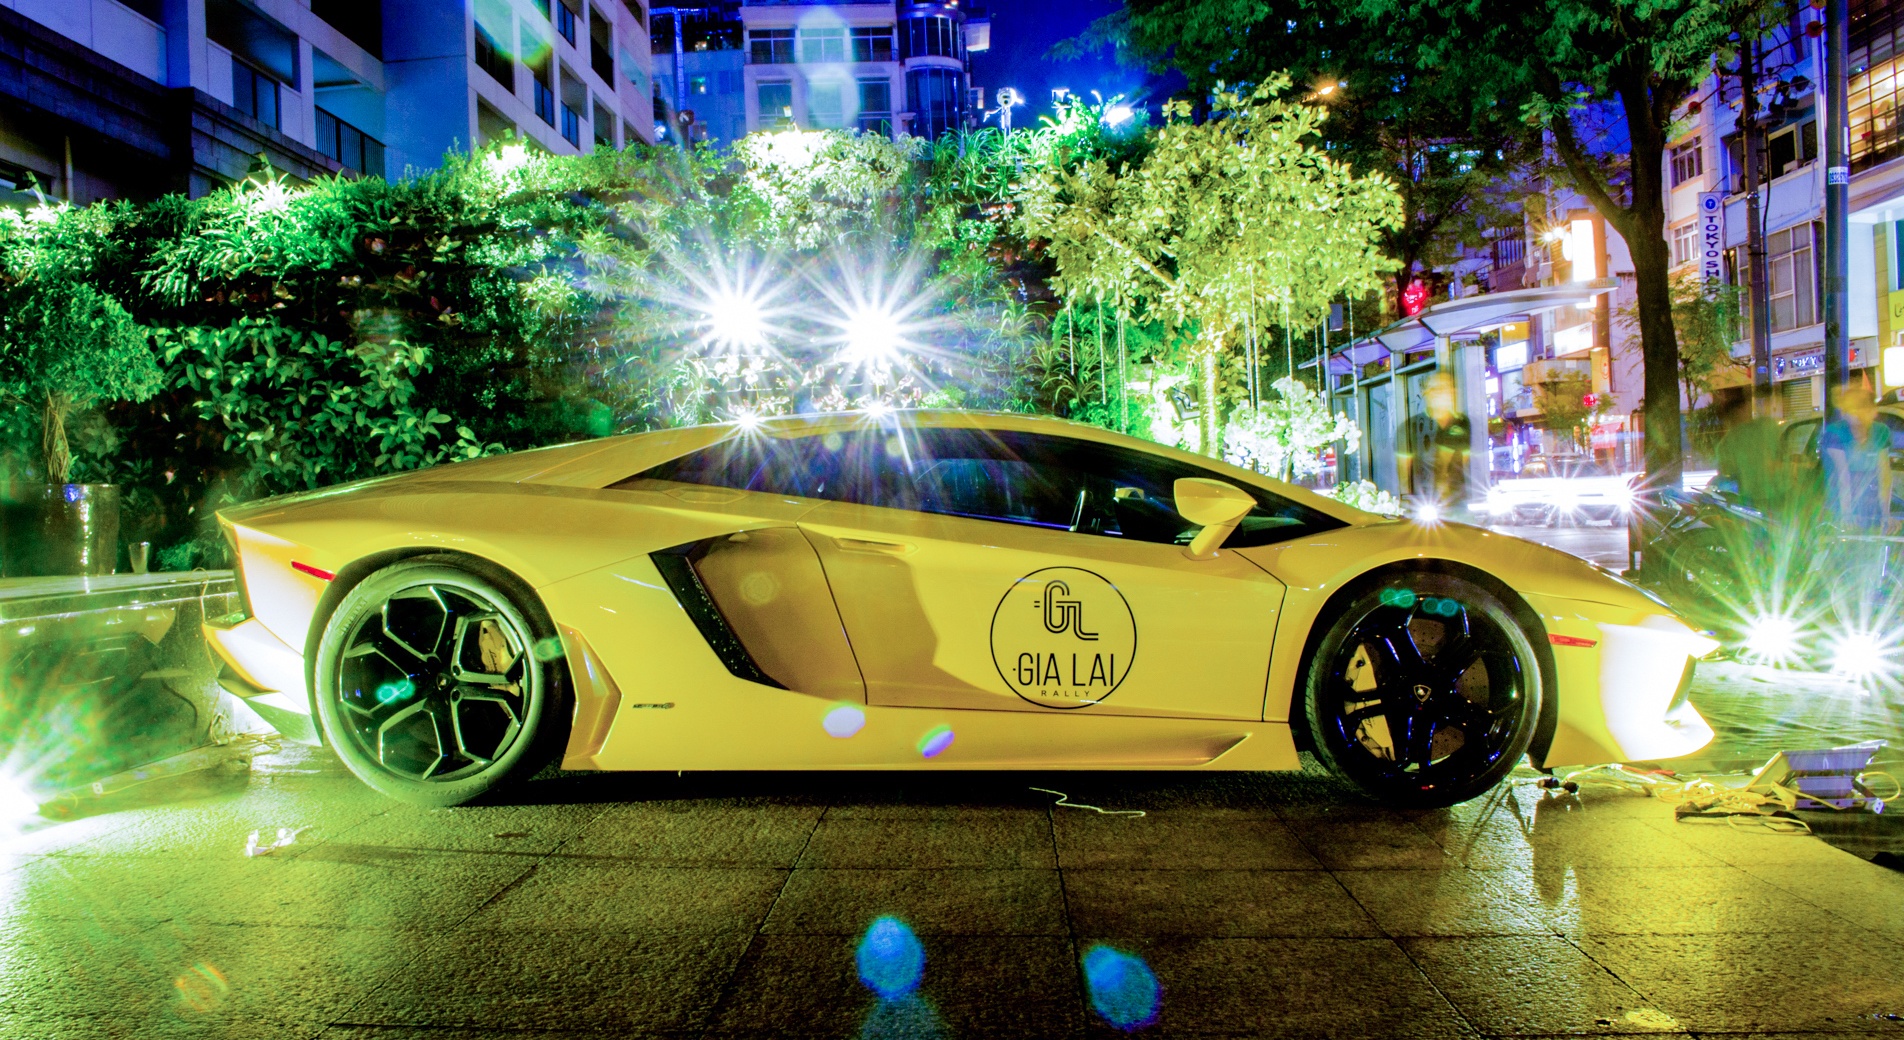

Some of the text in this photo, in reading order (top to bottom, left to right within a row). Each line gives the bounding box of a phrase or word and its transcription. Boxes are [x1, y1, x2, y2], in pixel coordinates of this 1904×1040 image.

[1705, 215, 1719, 258] TOKYO
[1017, 652, 1114, 687] GIA LAI
